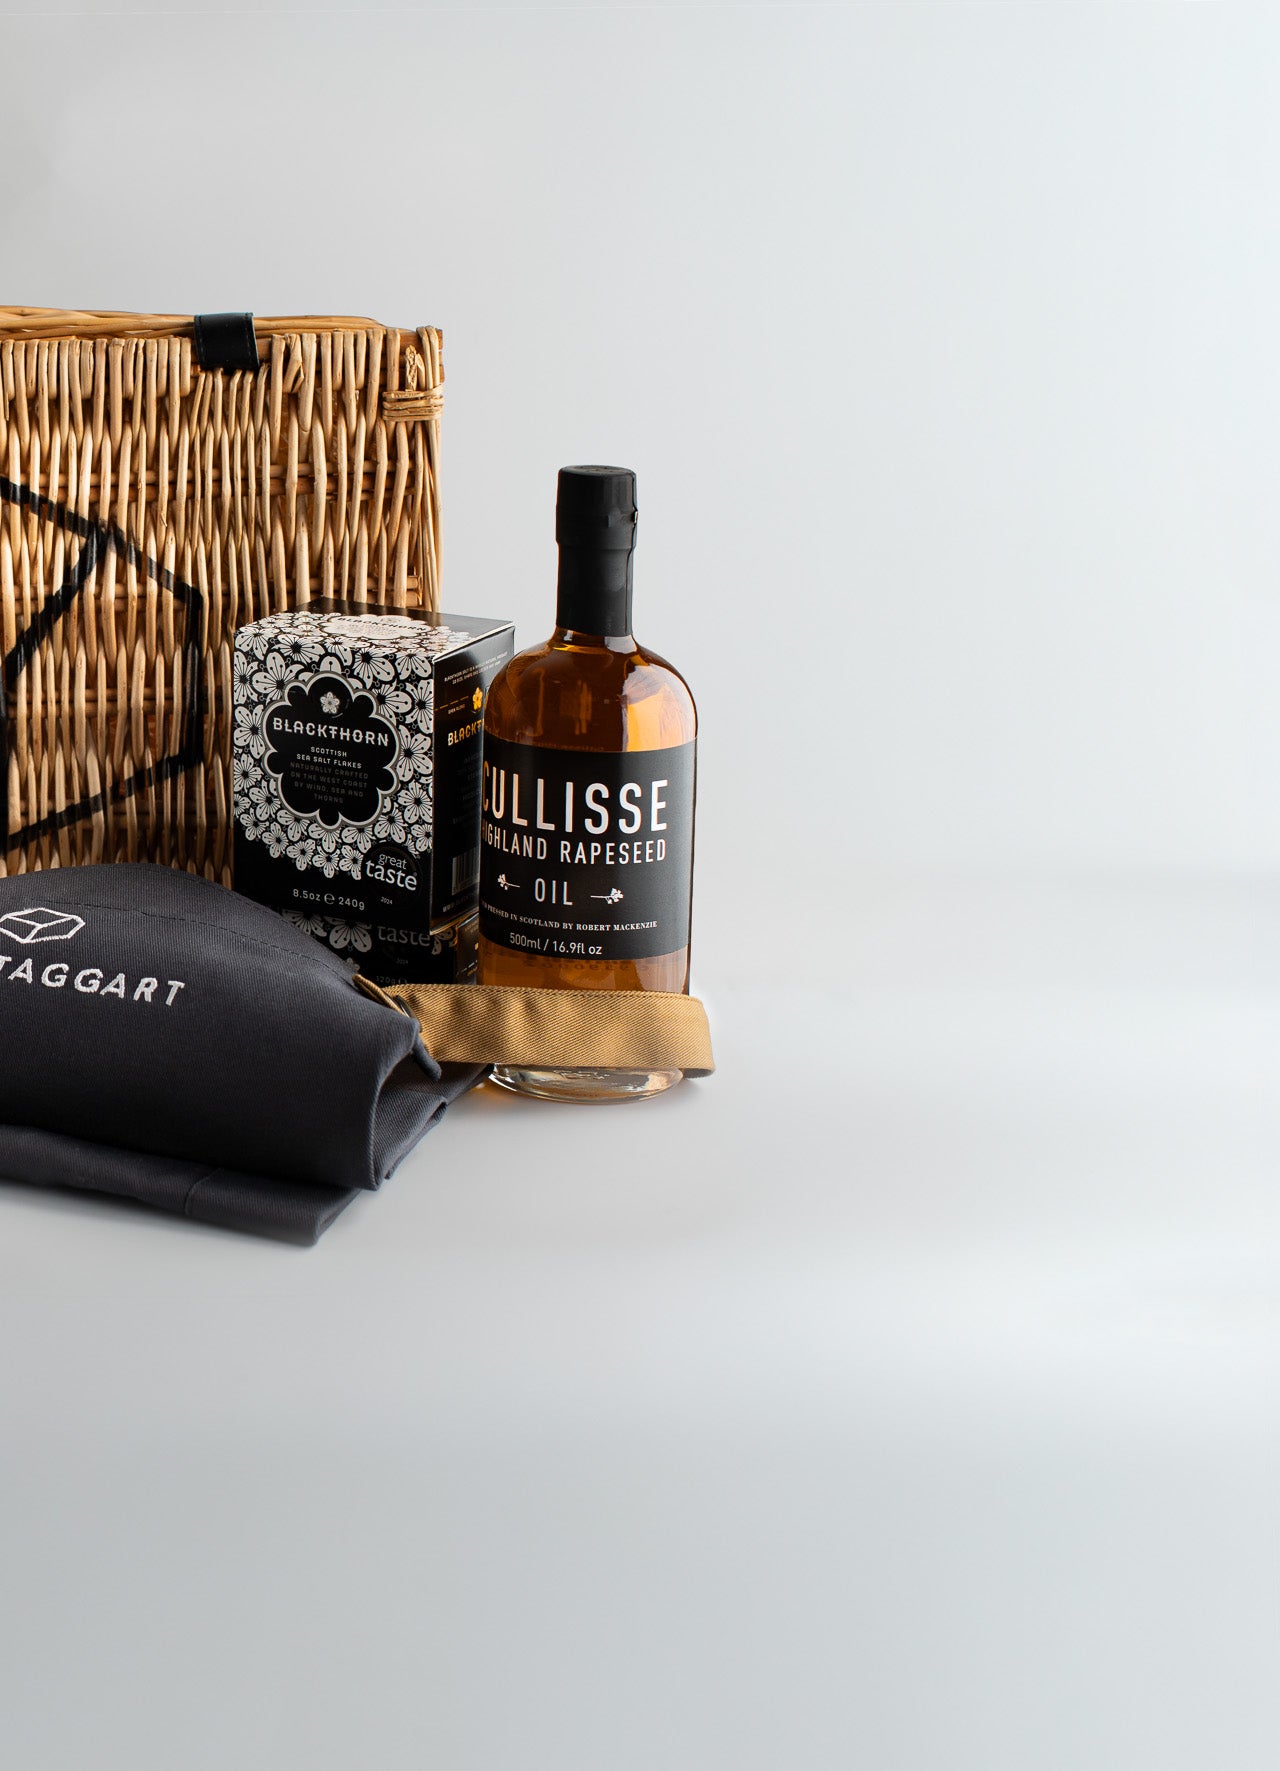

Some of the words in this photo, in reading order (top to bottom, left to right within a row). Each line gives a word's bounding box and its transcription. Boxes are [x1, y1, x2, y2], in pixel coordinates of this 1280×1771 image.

[272, 717, 389, 747] BLACKTHORN
[447, 718, 484, 747] BLACKT
[296, 753, 311, 761] SEA
[313, 756, 331, 765] SALT
[333, 759, 362, 769] FLAKES
[310, 746, 347, 757] SCOTTISH
[482, 760, 669, 835] CULLISSE
[378, 853, 408, 870] great
[560, 838, 667, 865] RAPESEED
[365, 860, 418, 892] taste
[292, 888, 321, 902] 8.5oz
[338, 897, 366, 911] 240g
[534, 878, 574, 906] OIL
[510, 912, 518, 921] IN
[519, 915, 560, 929] SCOTLAND
[562, 922, 573, 930] BY
[576, 923, 611, 931] ROBERT
[613, 920, 658, 931] MACKENZIE
[509, 932, 541, 950] 500ml
[552, 940, 586, 955] 16.9fl
[588, 945, 603, 955] oz
